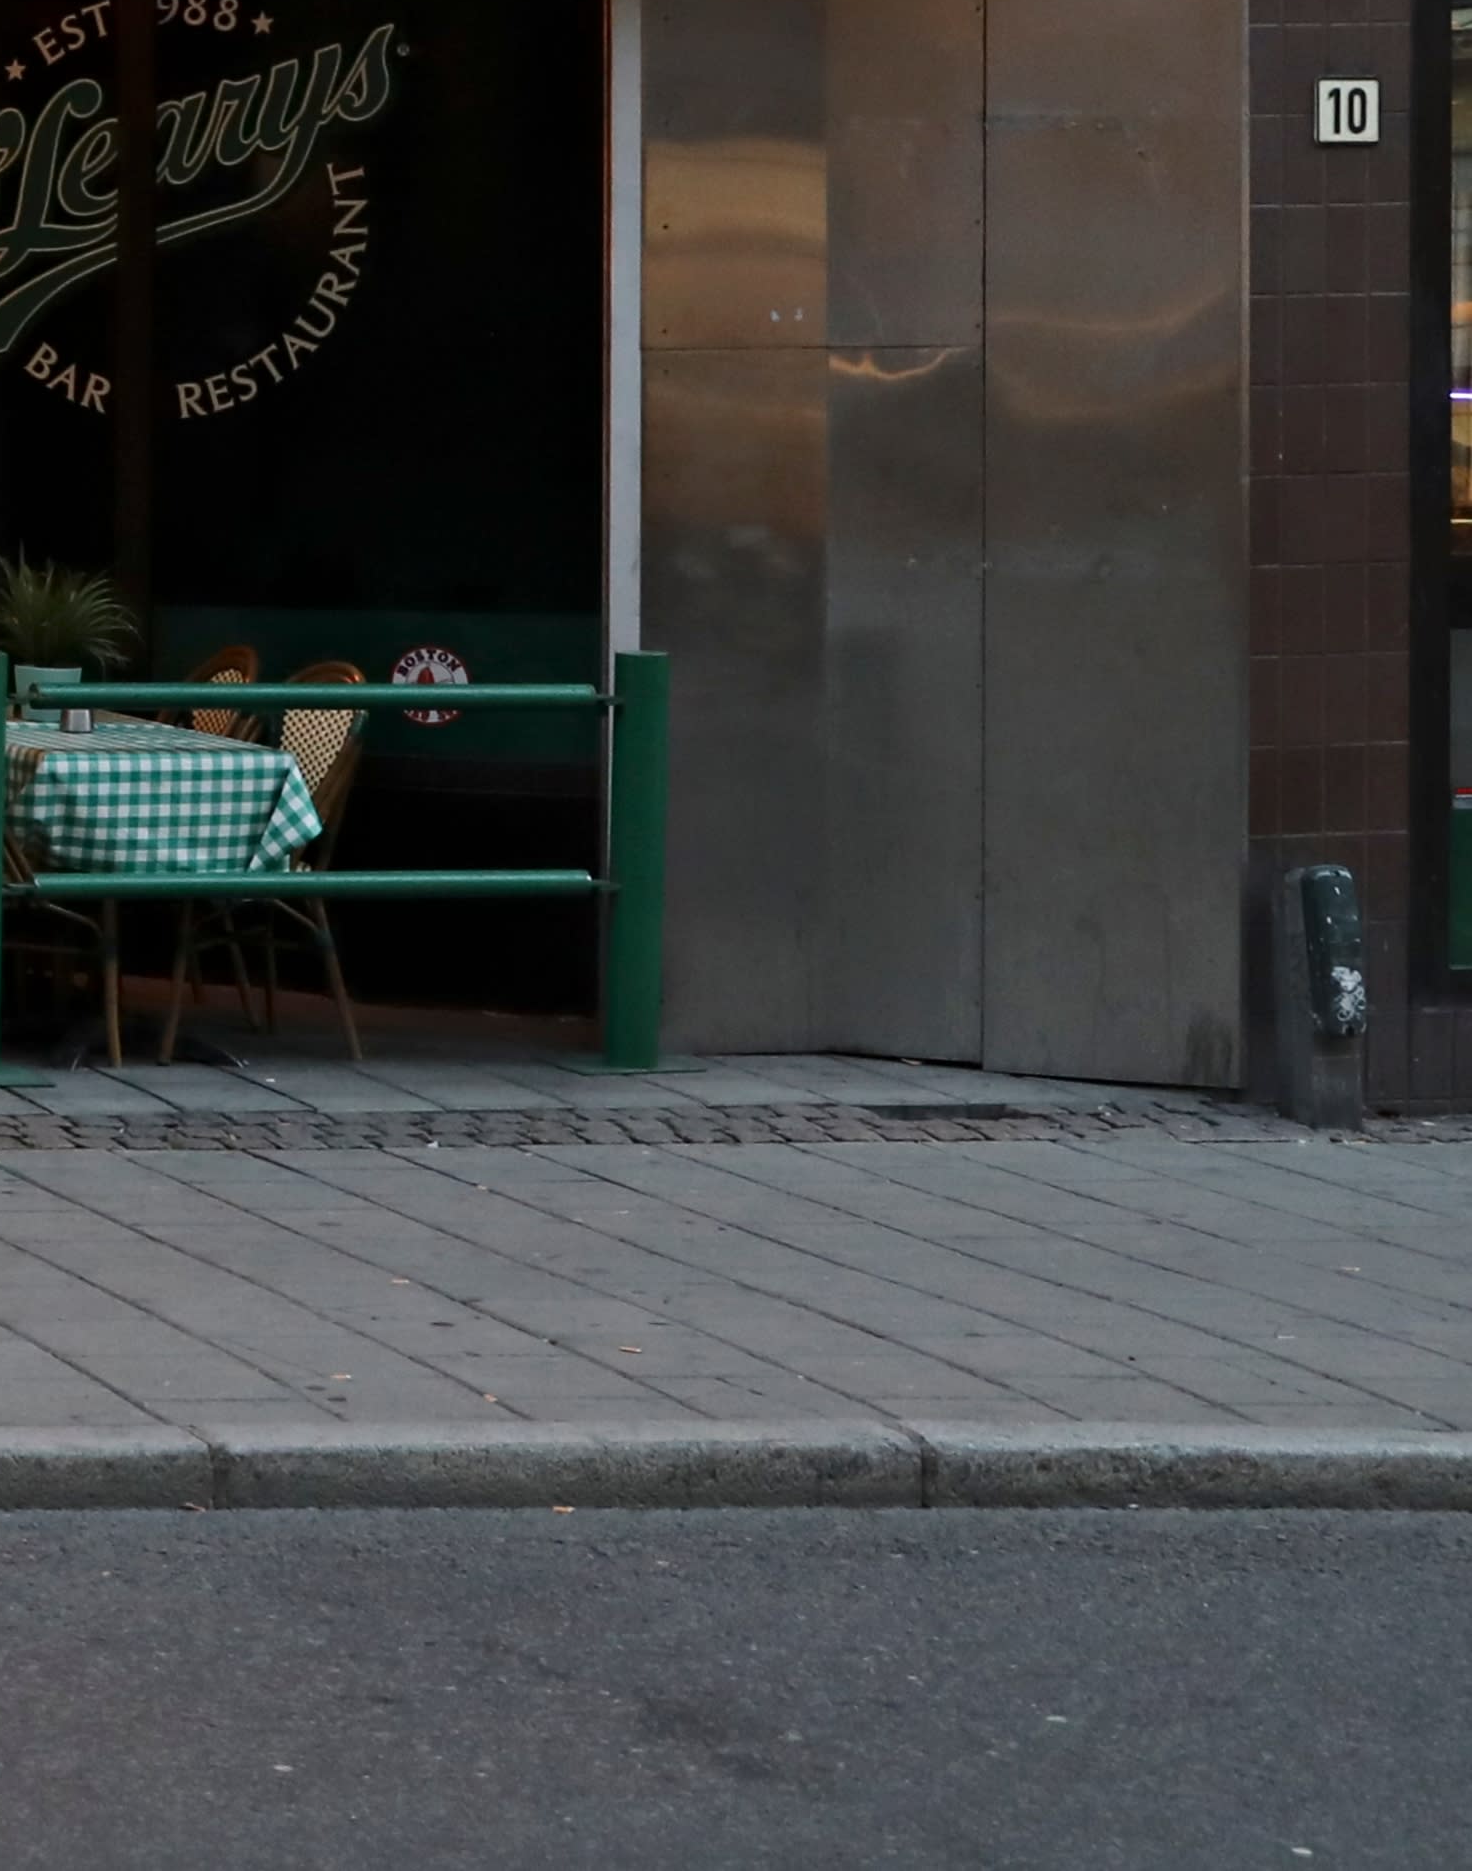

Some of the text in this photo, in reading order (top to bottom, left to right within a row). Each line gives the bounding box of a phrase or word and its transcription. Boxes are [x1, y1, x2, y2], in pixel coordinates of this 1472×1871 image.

[33, 0, 115, 65] EST
[1328, 87, 1366, 134] 10
[23, 162, 370, 420] BAR RESTAURANT
[397, 649, 461, 677] BOSTON
